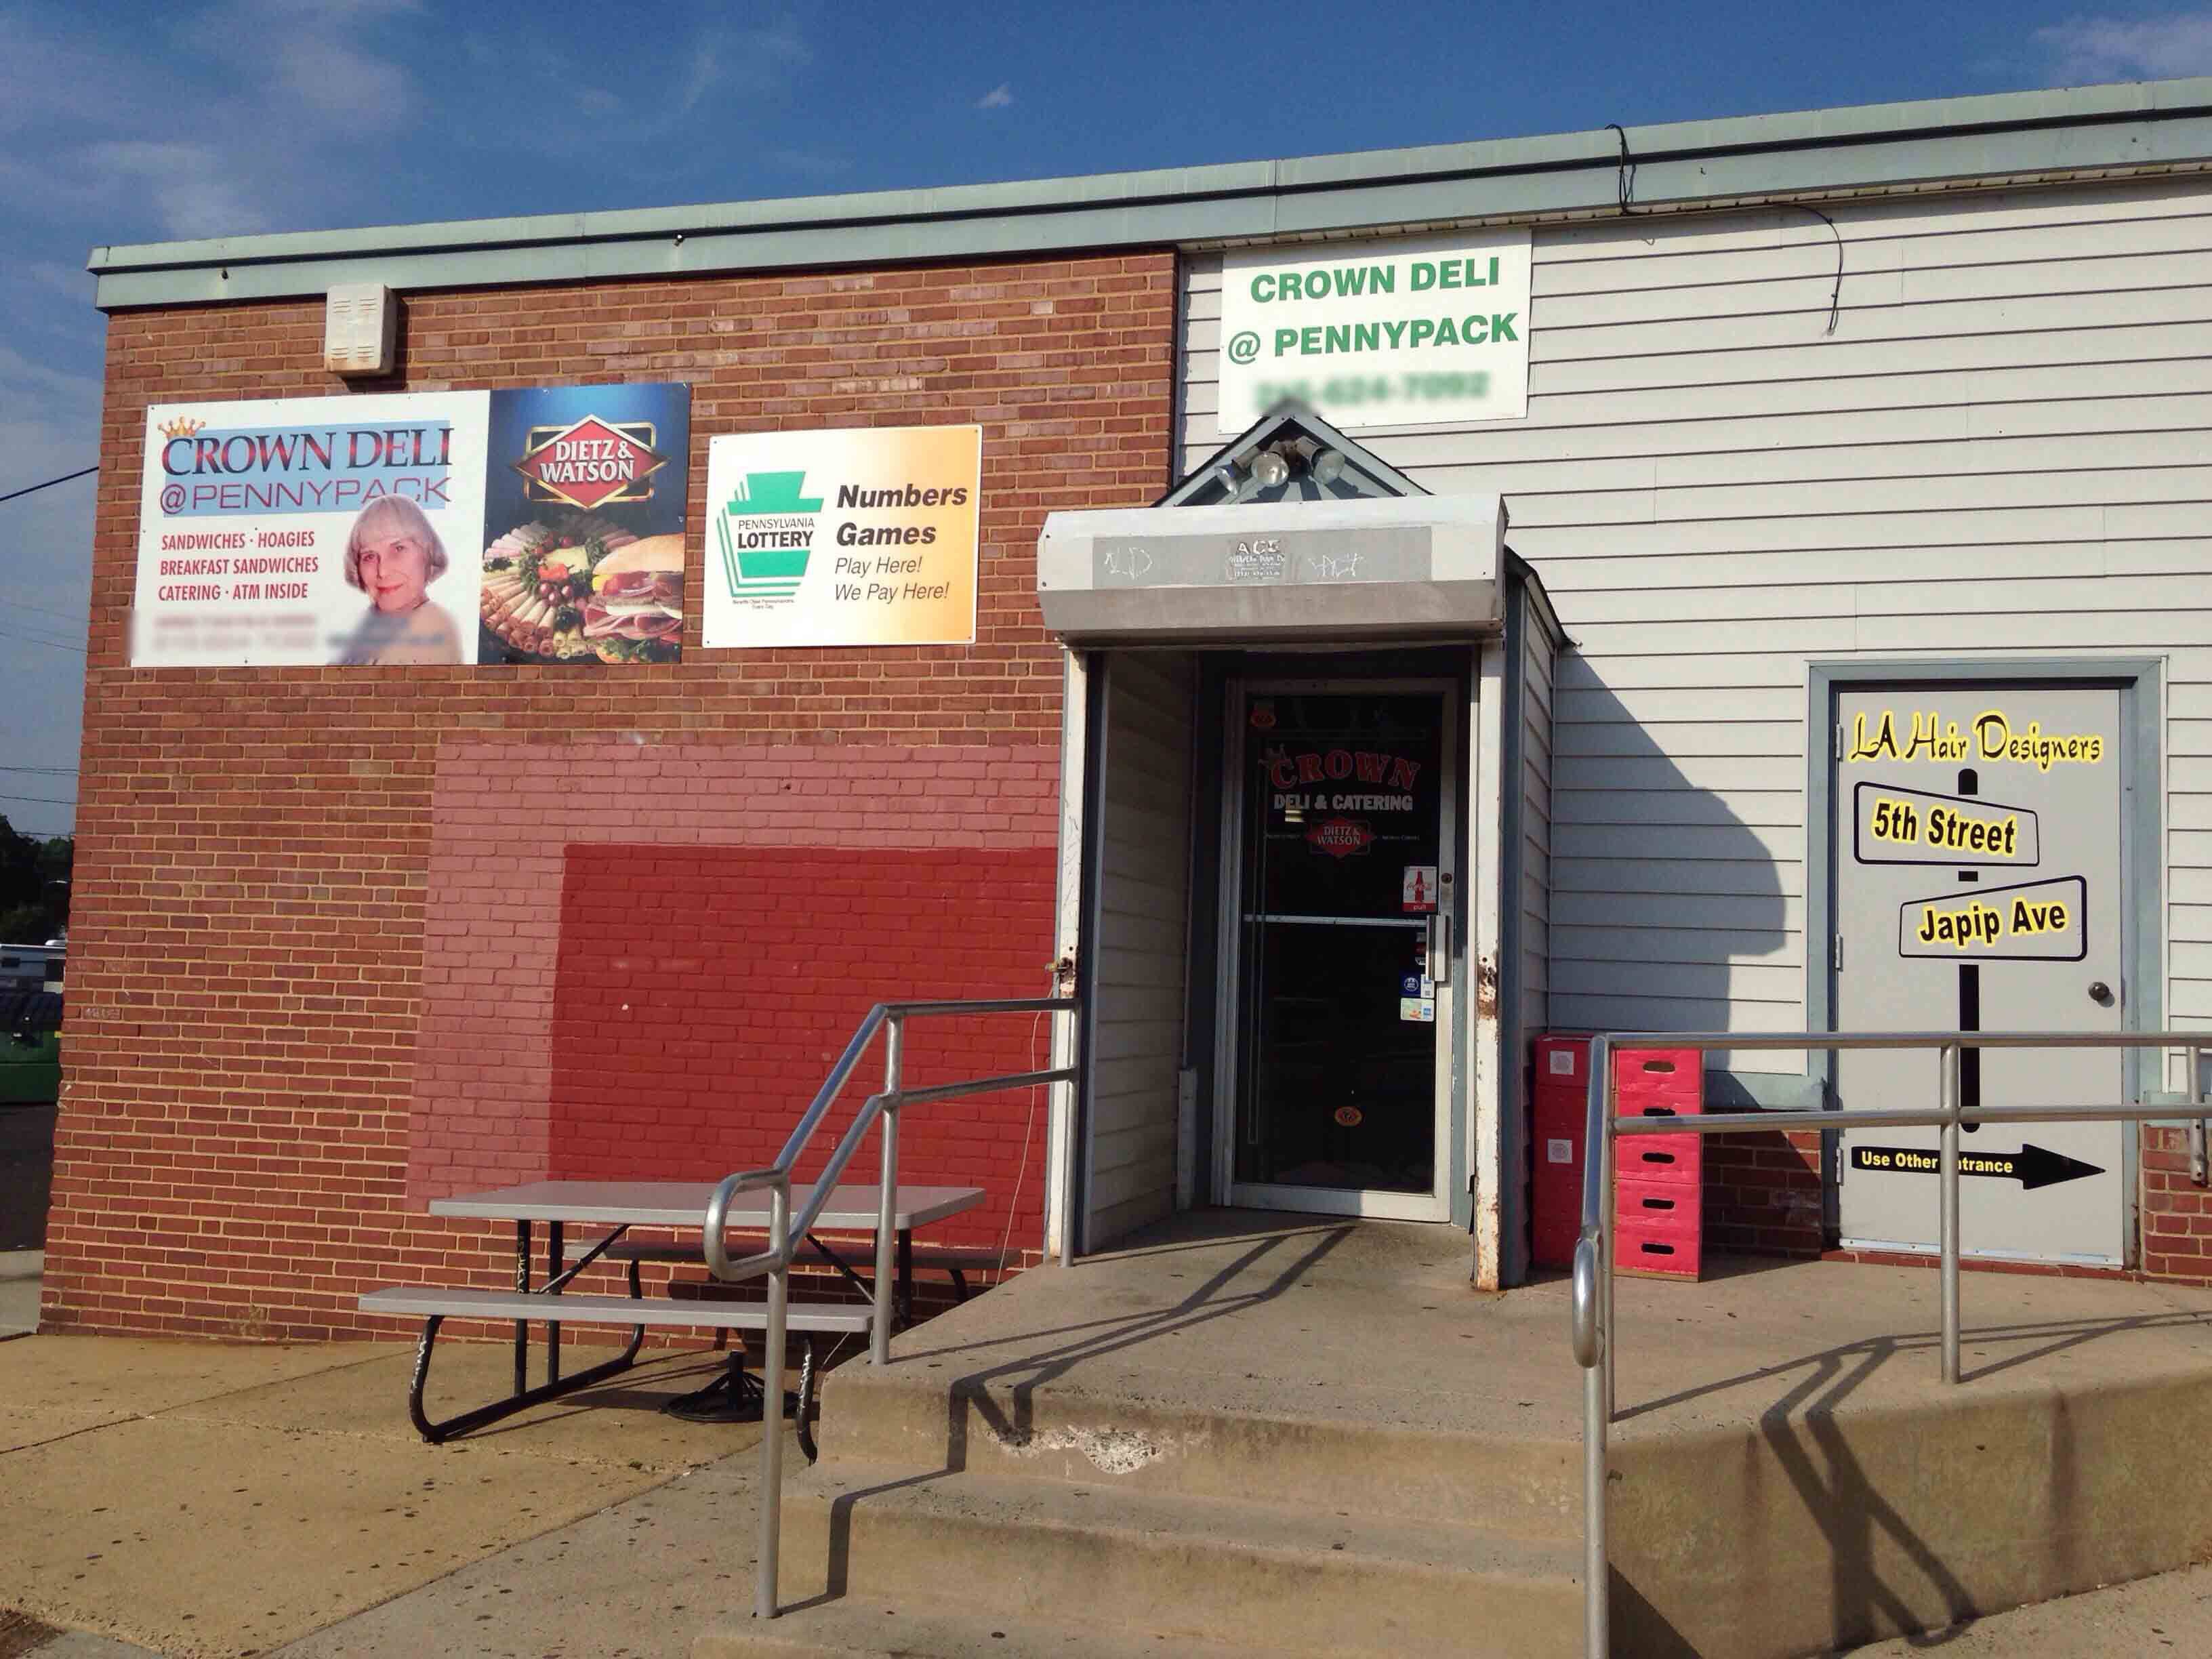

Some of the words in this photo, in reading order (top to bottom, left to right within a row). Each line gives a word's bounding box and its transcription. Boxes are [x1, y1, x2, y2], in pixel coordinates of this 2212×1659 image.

[1250, 265, 1395, 304] CROWN
[1410, 256, 1500, 291] DELI
[1227, 330, 1261, 365] @
[1275, 312, 1519, 357] PENNYPACK
[161, 430, 337, 476] CROWN
[346, 427, 455, 469] DELI
[555, 439, 615, 462] DIETZ
[617, 441, 635, 459] &
[539, 460, 635, 483] WATSON
[837, 483, 968, 508] Numbers
[738, 517, 815, 530] PENNSYLVANIA
[836, 522, 937, 546] Games
[161, 533, 246, 551] SANDWICHES
[258, 531, 315, 548] HOAGIES
[737, 531, 813, 549] LOTTERY
[160, 558, 230, 576] BREAKFAST
[233, 556, 319, 575] SANDWICHES
[835, 556, 872, 578] Play
[876, 555, 922, 574] Here!
[158, 584, 221, 602] CATERING
[232, 583, 261, 600] ATM
[264, 582, 309, 600] INSIDE
[835, 583, 861, 601] We
[867, 583, 899, 605] Pay
[903, 581, 949, 600] Here!
[1851, 713, 1898, 760] LA
[1905, 713, 1967, 760] Hair
[1975, 712, 2102, 771] Designers
[1269, 749, 1421, 791] CROWN
[1273, 794, 1311, 811] DELI
[1314, 794, 1328, 811] &
[1332, 794, 1414, 812] CATERING
[1323, 825, 1351, 836] DIETZ
[1873, 801, 1918, 842] 5th
[1927, 808, 2016, 855] Street
[1317, 834, 1361, 846] WATSON
[1919, 904, 2001, 947] Japip
[2012, 900, 2066, 933] Ave
[1861, 1151, 1891, 1166] Use
[1895, 1153, 1938, 1169] Other
[1957, 1157, 2013, 1173] trance
